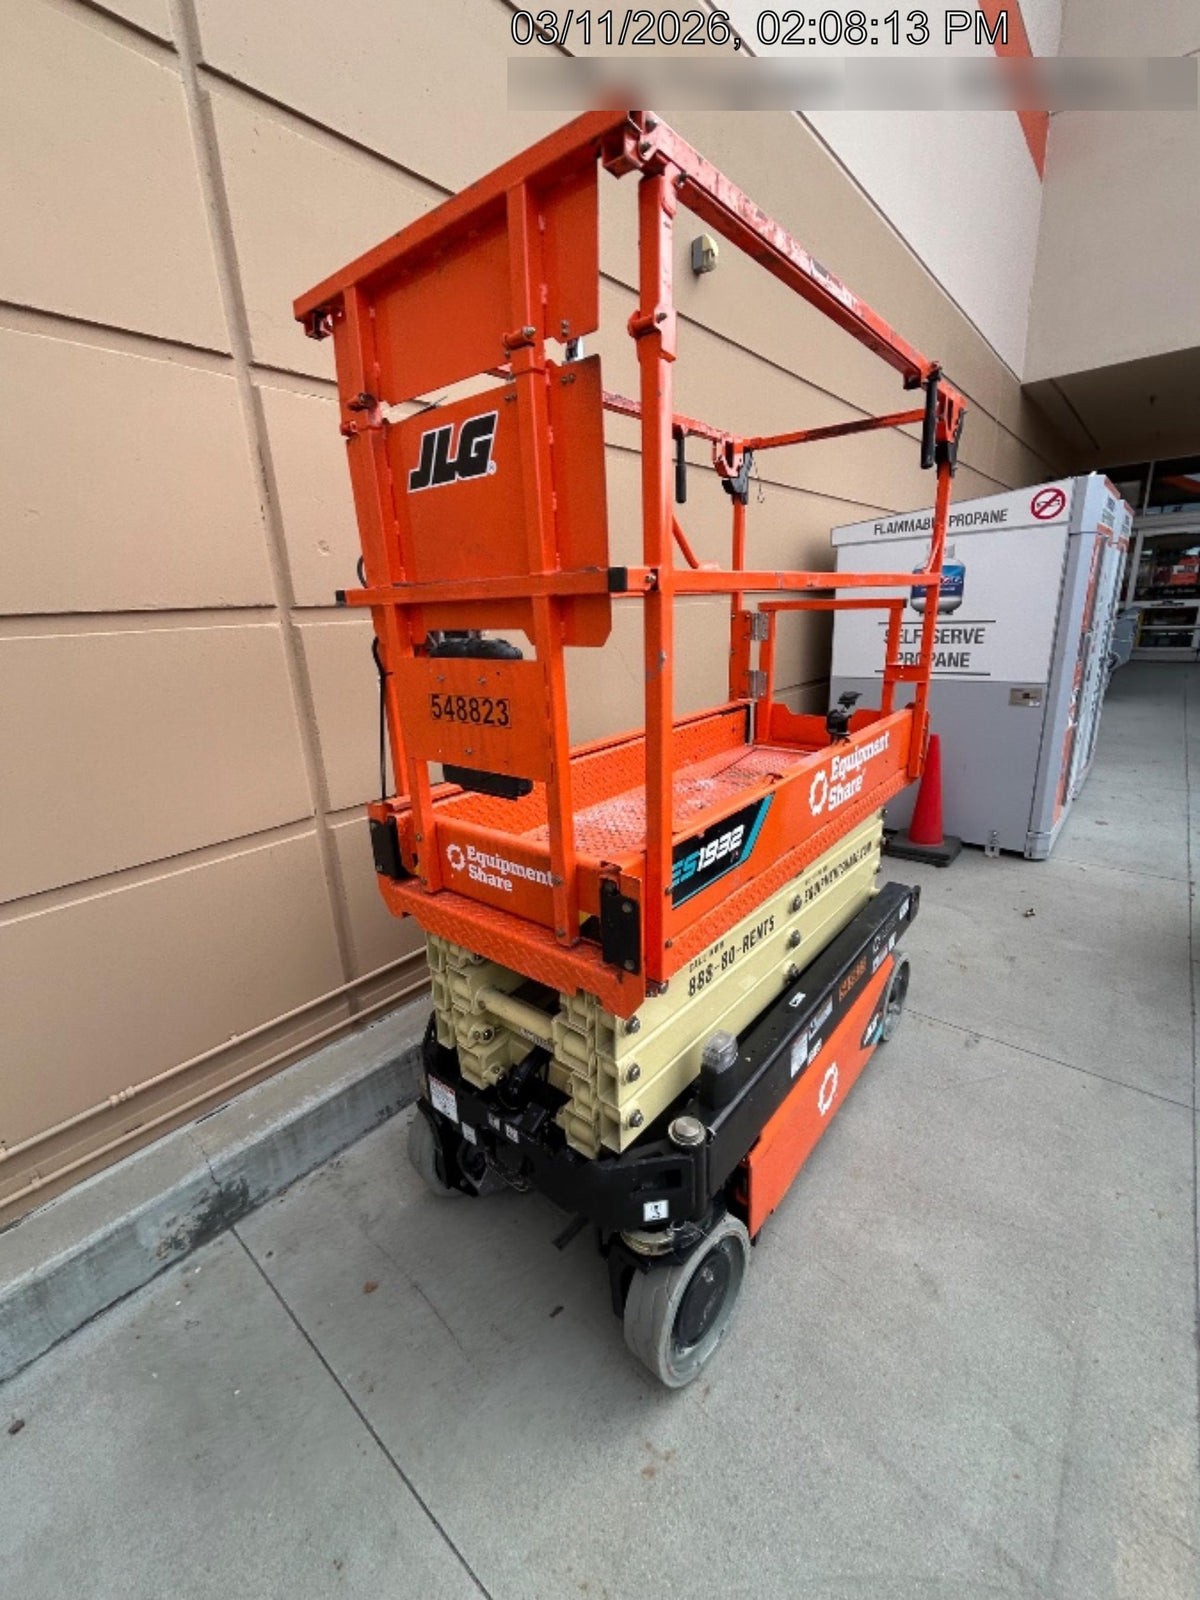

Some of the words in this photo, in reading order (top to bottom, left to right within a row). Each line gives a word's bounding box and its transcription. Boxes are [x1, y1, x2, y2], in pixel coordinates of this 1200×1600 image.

[408, 411, 498, 492] JLG
[872, 516, 935, 536] FLAMMAB
[949, 508, 1009, 528] PROPANE
[934, 627, 986, 644] SERVE
[431, 693, 509, 726] 548823
[830, 729, 890, 783] Equipment
[828, 783, 863, 812] Share
[466, 845, 554, 887] Equipment
[671, 824, 745, 887] ES1932
[468, 865, 513, 892] Share
[688, 914, 775, 998] 888-80-RENTS
